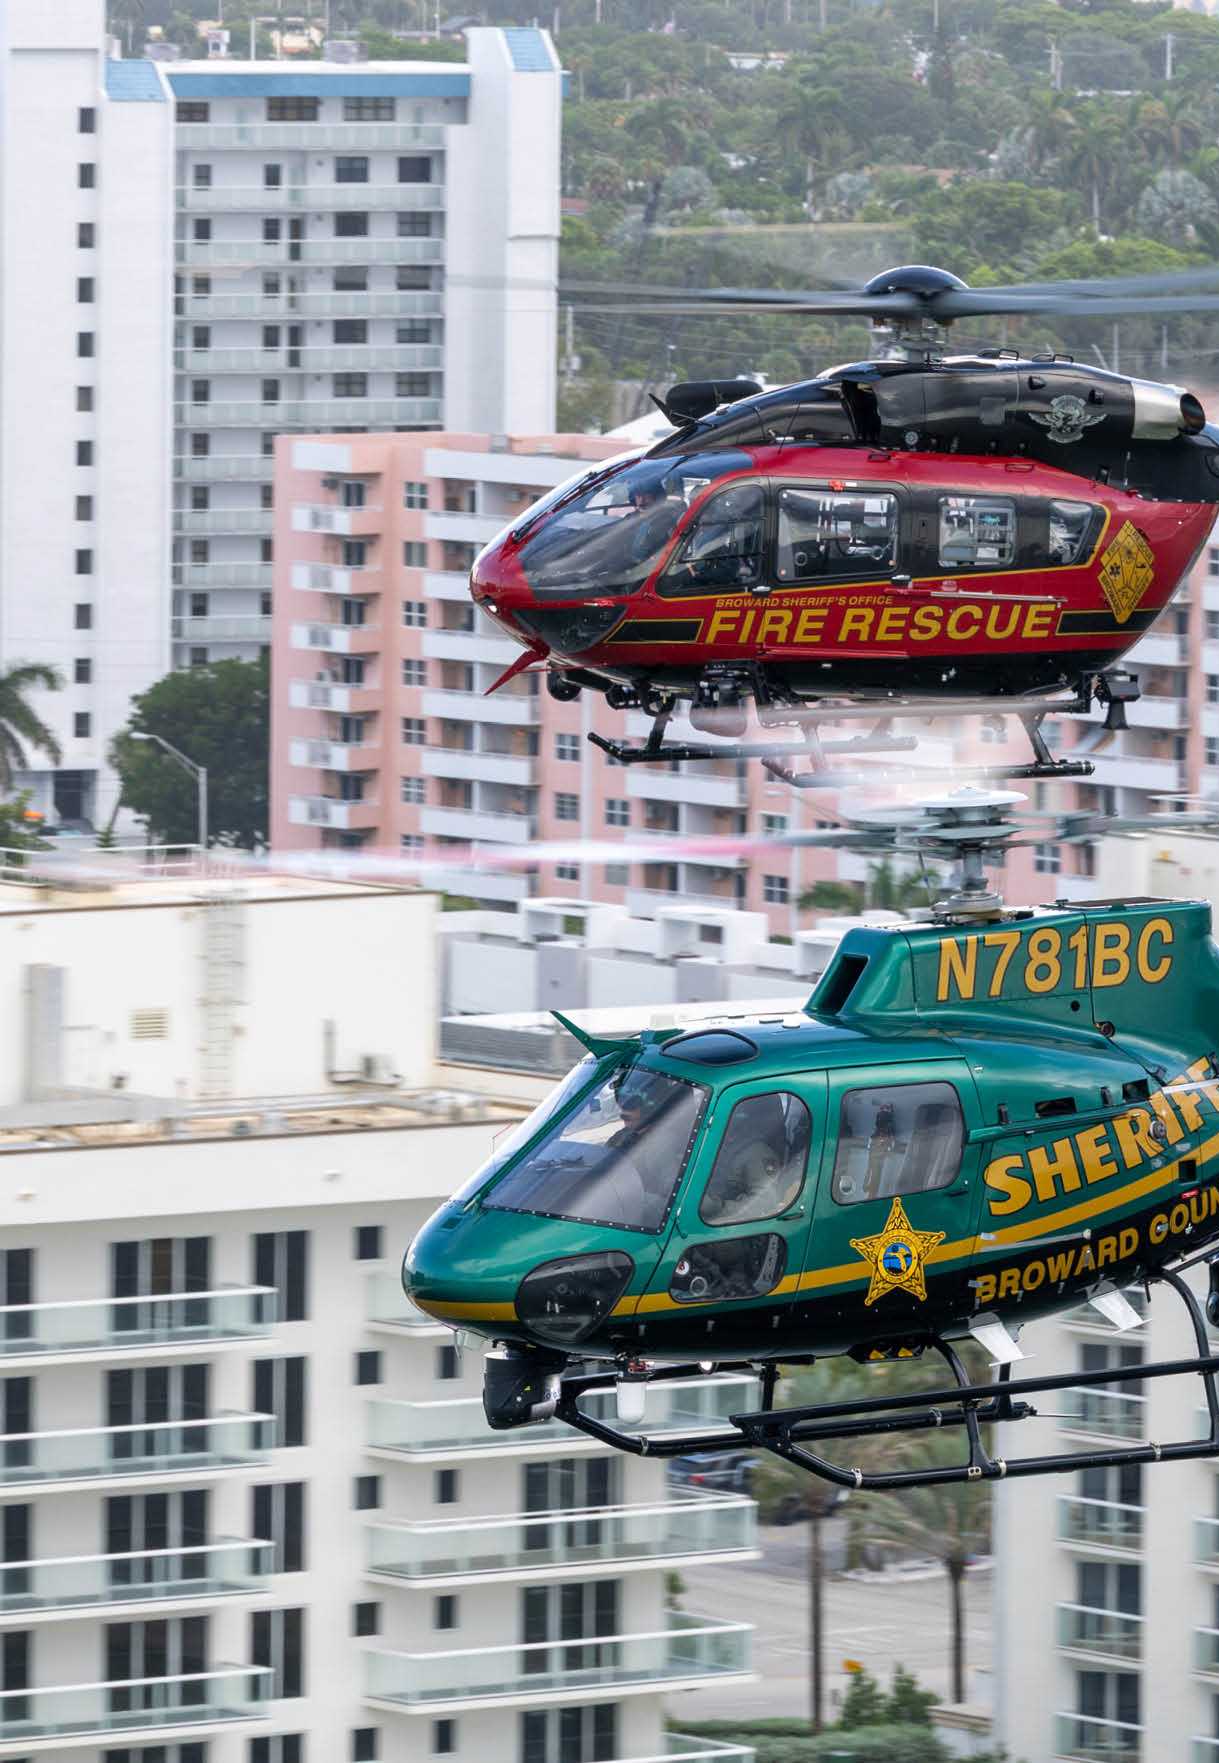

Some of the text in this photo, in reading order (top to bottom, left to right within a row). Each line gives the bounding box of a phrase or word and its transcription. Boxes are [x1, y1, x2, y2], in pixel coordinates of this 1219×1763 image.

[705, 604, 1057, 644] FIRE RESCUE
[715, 594, 894, 608] BROWARD SHERIFF'S OFFICE
[935, 917, 1175, 1003] N781BC
[975, 1226, 1140, 1304] BROWARD
